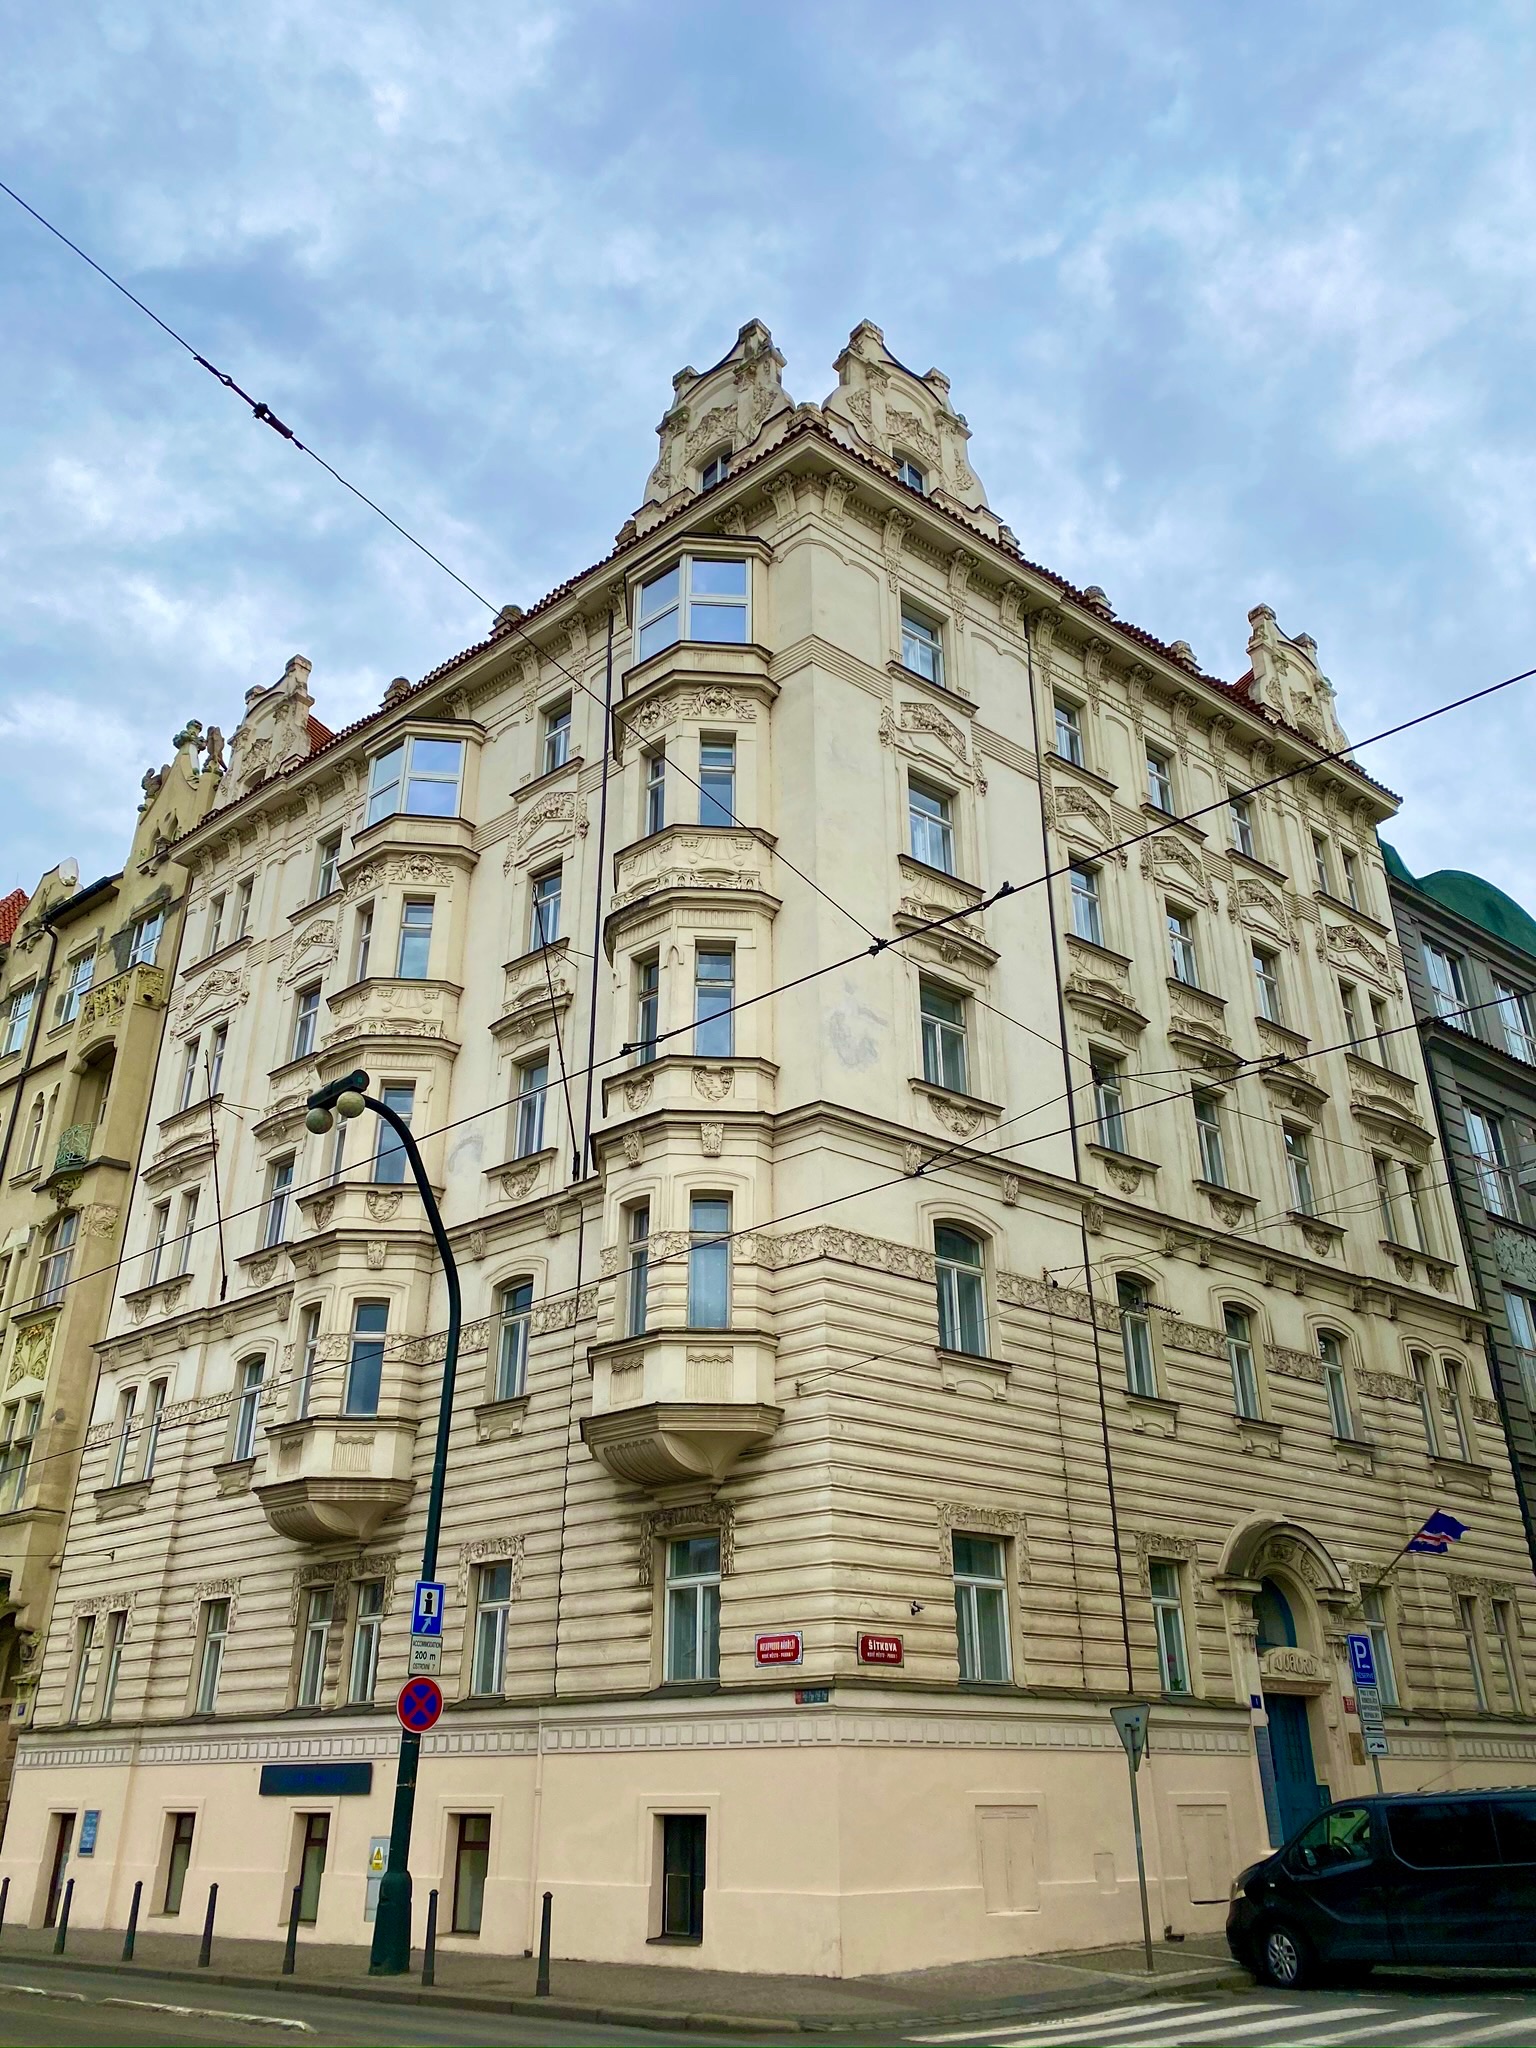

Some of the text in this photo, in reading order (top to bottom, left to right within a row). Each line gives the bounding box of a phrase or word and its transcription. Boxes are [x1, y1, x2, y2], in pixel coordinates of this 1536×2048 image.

[868, 1639, 897, 1652] ŠÍTKOVA
[415, 1650, 427, 1660] 200
[1353, 1640, 1367, 1669] P
